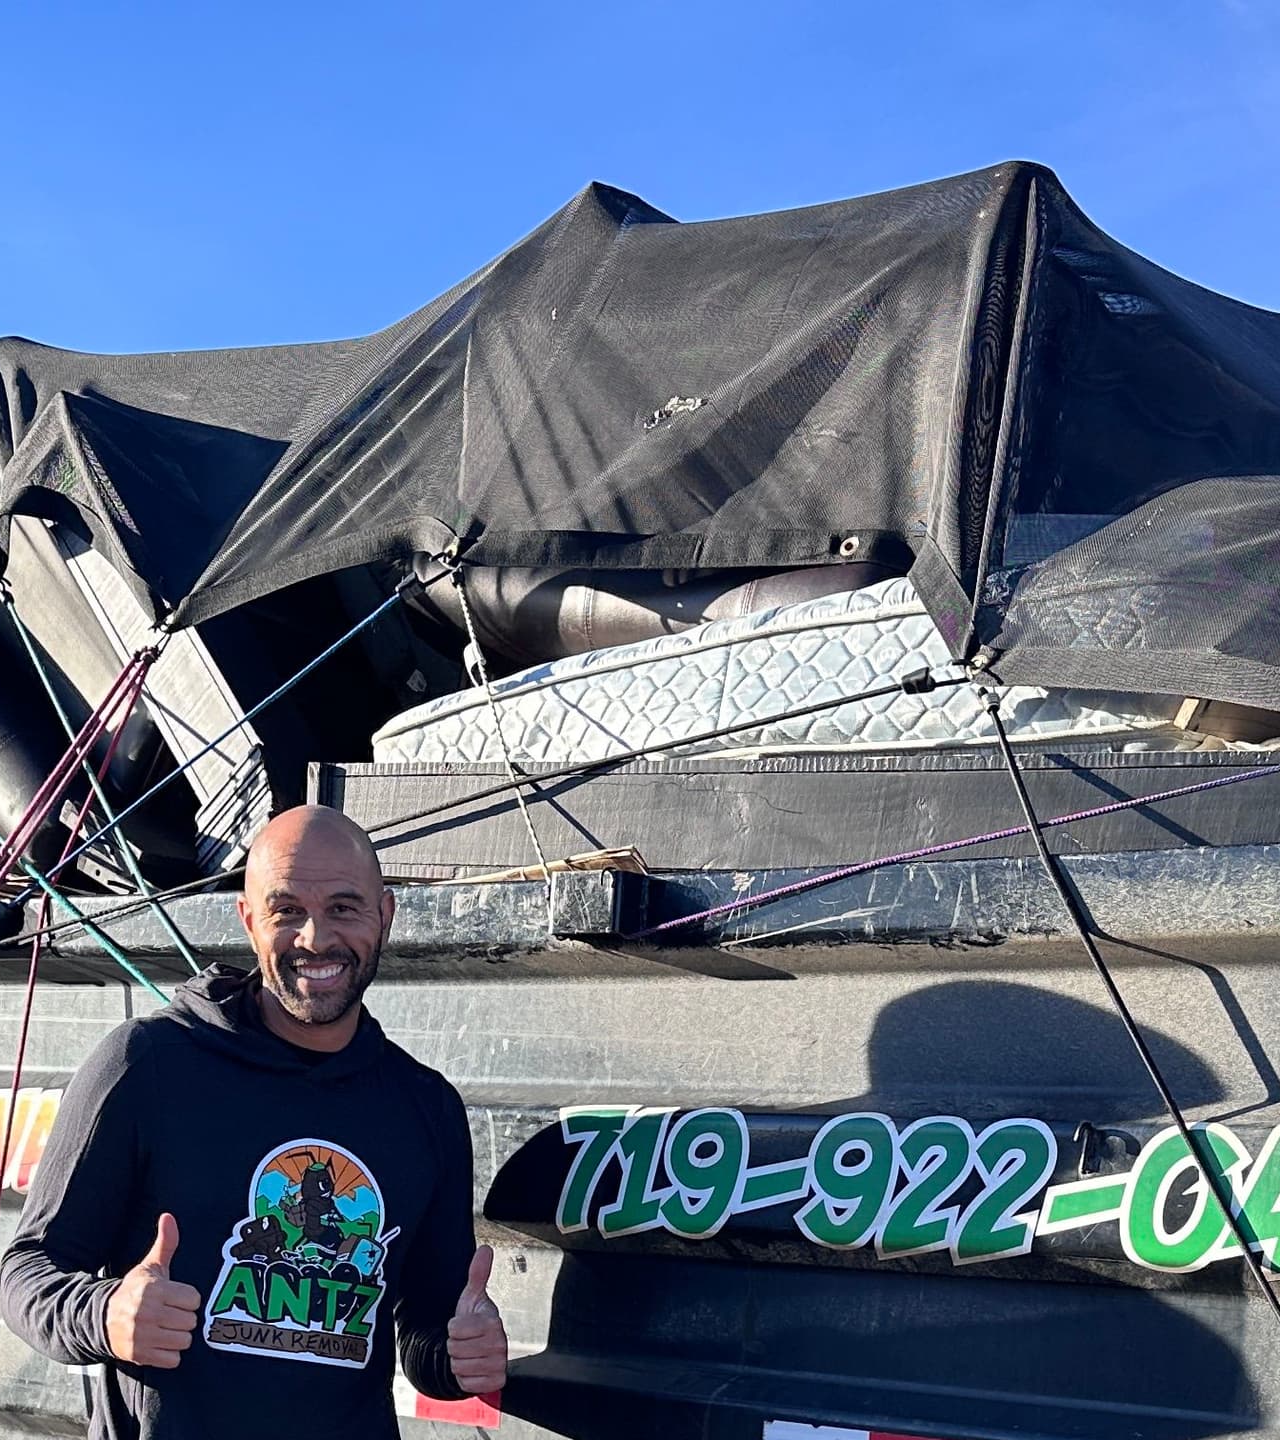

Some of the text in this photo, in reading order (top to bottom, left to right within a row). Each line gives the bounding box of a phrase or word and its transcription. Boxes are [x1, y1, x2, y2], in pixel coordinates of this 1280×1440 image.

[211, 1265, 384, 1336] ANTZ
[222, 1321, 364, 1356] JUNK REMOVAL
